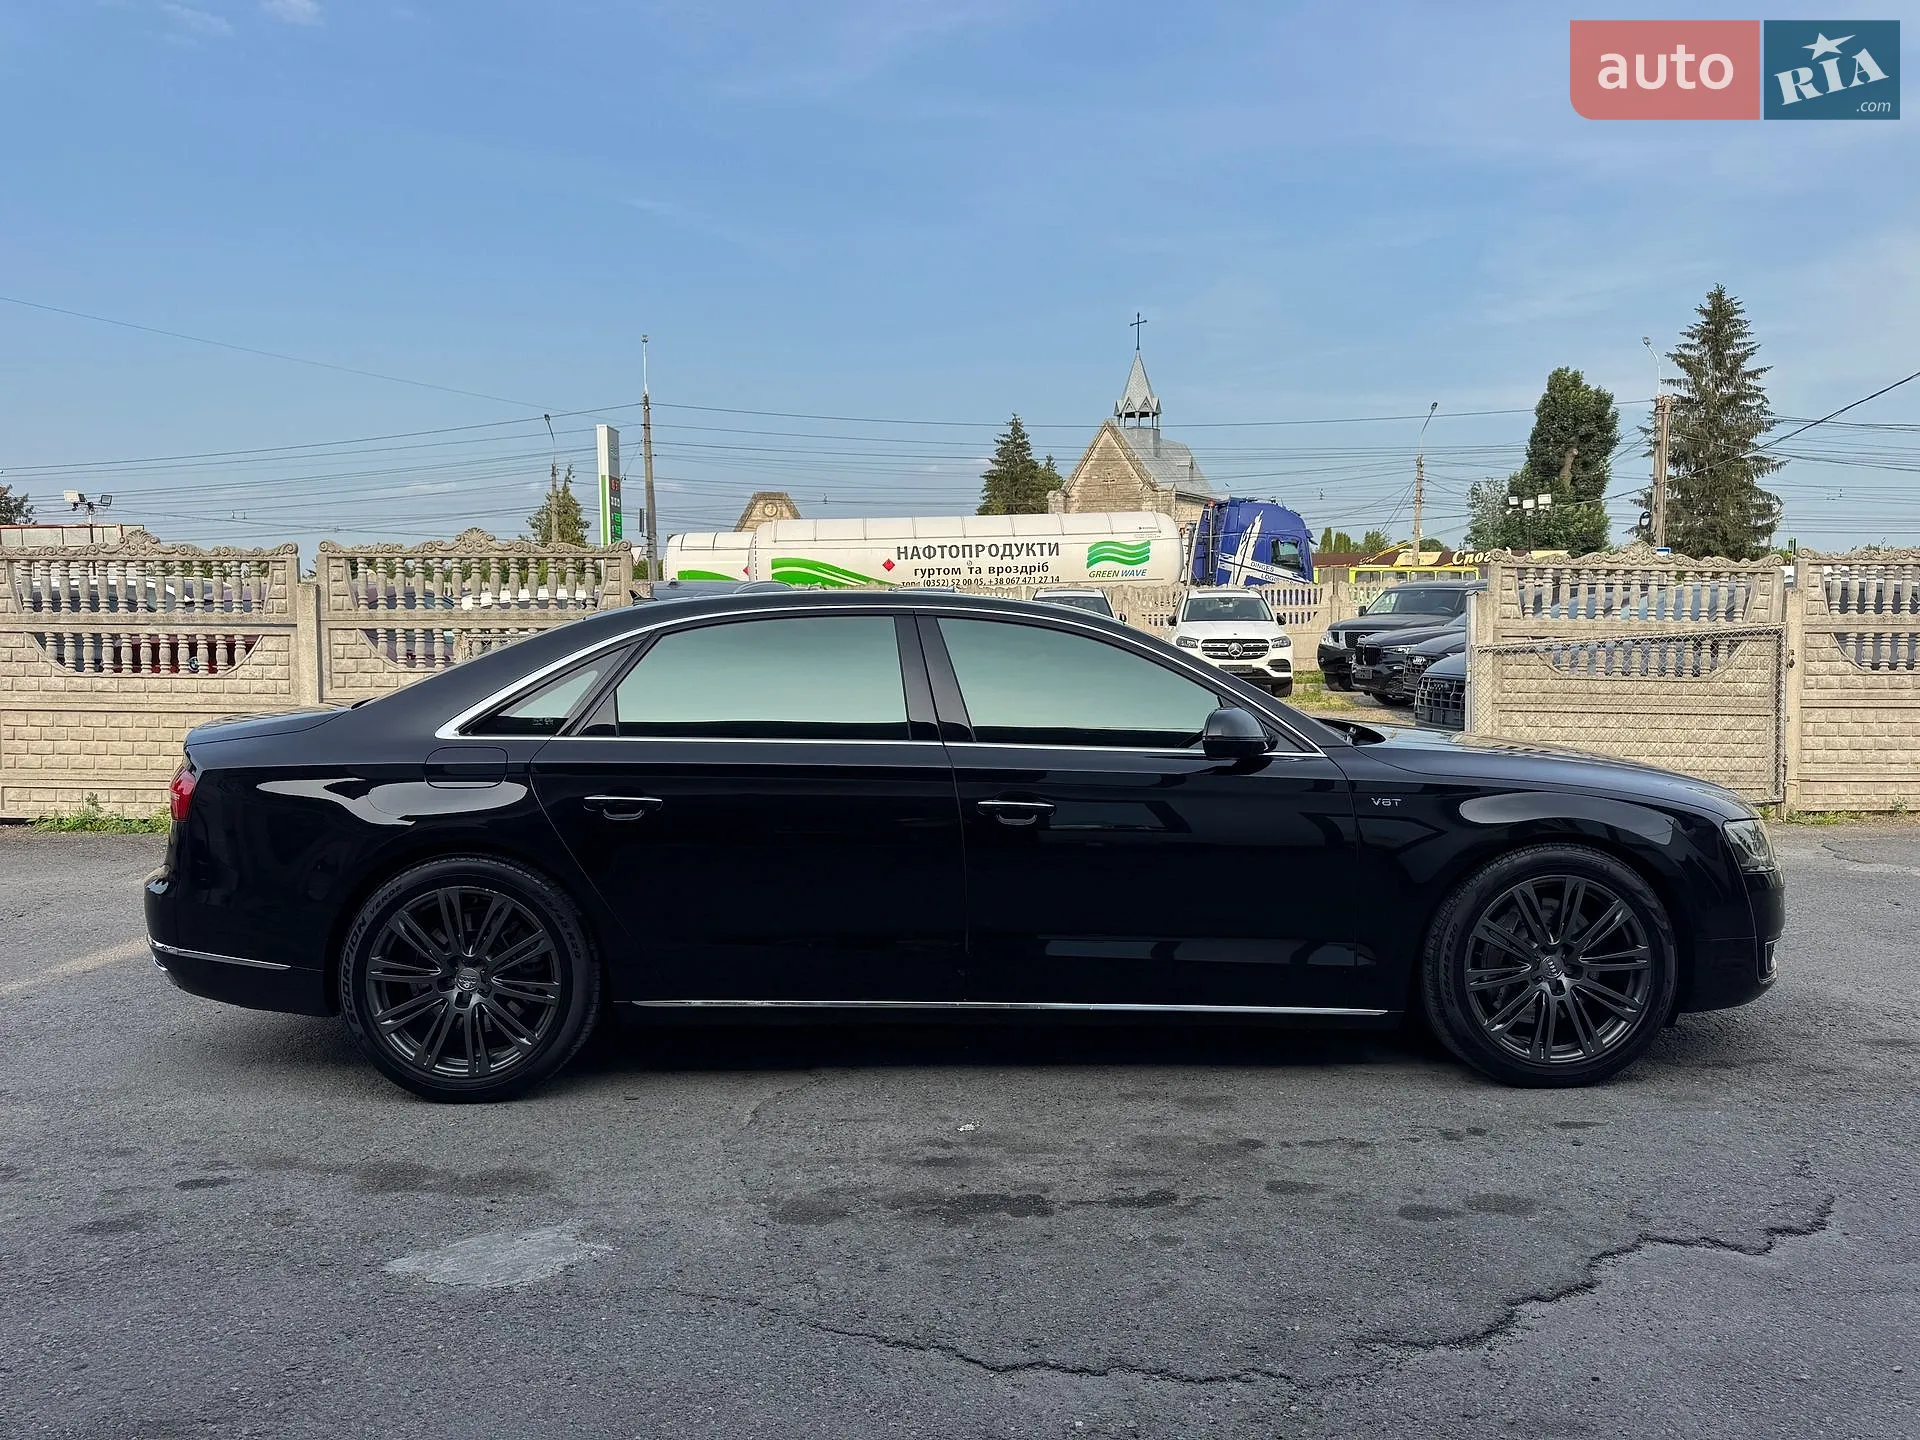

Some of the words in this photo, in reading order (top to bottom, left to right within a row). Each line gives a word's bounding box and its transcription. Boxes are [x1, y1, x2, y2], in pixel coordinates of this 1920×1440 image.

[896, 542, 1060, 560] НАФТОПРОДУКТИ
[914, 565, 962, 578] гуртом
[967, 564, 982, 576] та
[988, 562, 1050, 577] вроздріб
[1088, 569, 1120, 578] GREEN
[1120, 568, 1147, 577] WAVE
[924, 579, 949, 587] (0352)
[987, 577, 1004, 585] +38
[1006, 576, 1020, 585] 067
[1022, 576, 1036, 584] 471
[1038, 576, 1048, 584] 27
[1051, 575, 1060, 584] 14
[1371, 797, 1402, 806] V8T
